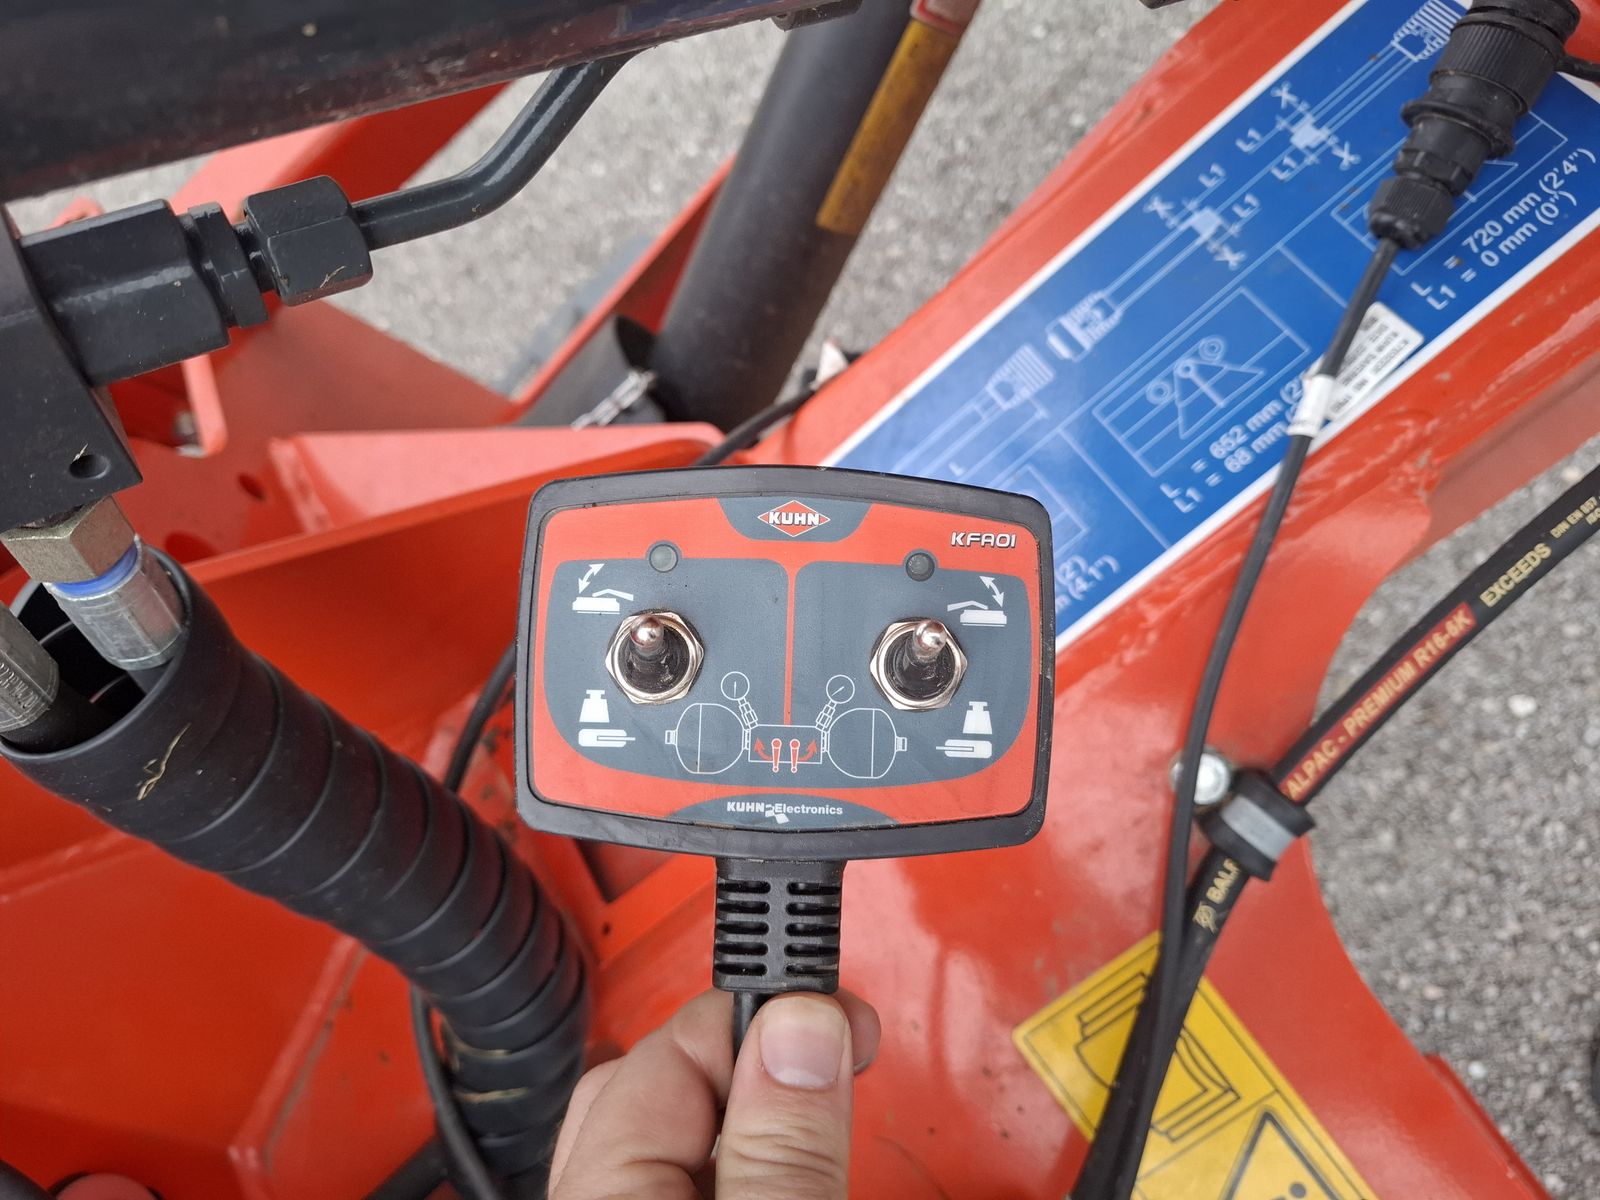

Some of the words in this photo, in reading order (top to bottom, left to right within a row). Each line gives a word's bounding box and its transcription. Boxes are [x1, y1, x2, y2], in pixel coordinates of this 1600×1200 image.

[1236, 128, 1262, 152] L1
[1198, 163, 1225, 188] L1
[1271, 156, 1297, 180] L1
[1232, 193, 1260, 218] L1
[1411, 281, 1433, 297] L
[1462, 220, 1504, 253] 720
[1502, 192, 1541, 224] mm
[1427, 285, 1456, 310] L1
[1481, 250, 1499, 267] 0
[1498, 222, 1539, 255] mm
[1209, 425, 1250, 459] 652
[1246, 400, 1284, 432] mm
[1173, 487, 1203, 513] L1
[1251, 421, 1289, 454] mm
[768, 511, 820, 526] KUHN
[1480, 542, 1552, 607] EXCEEDS
[1286, 739, 1339, 801] ALPAC
[1343, 660, 1418, 737] PREMIUM
[727, 801, 765, 813] KUHN
[774, 803, 843, 815] Electronics
